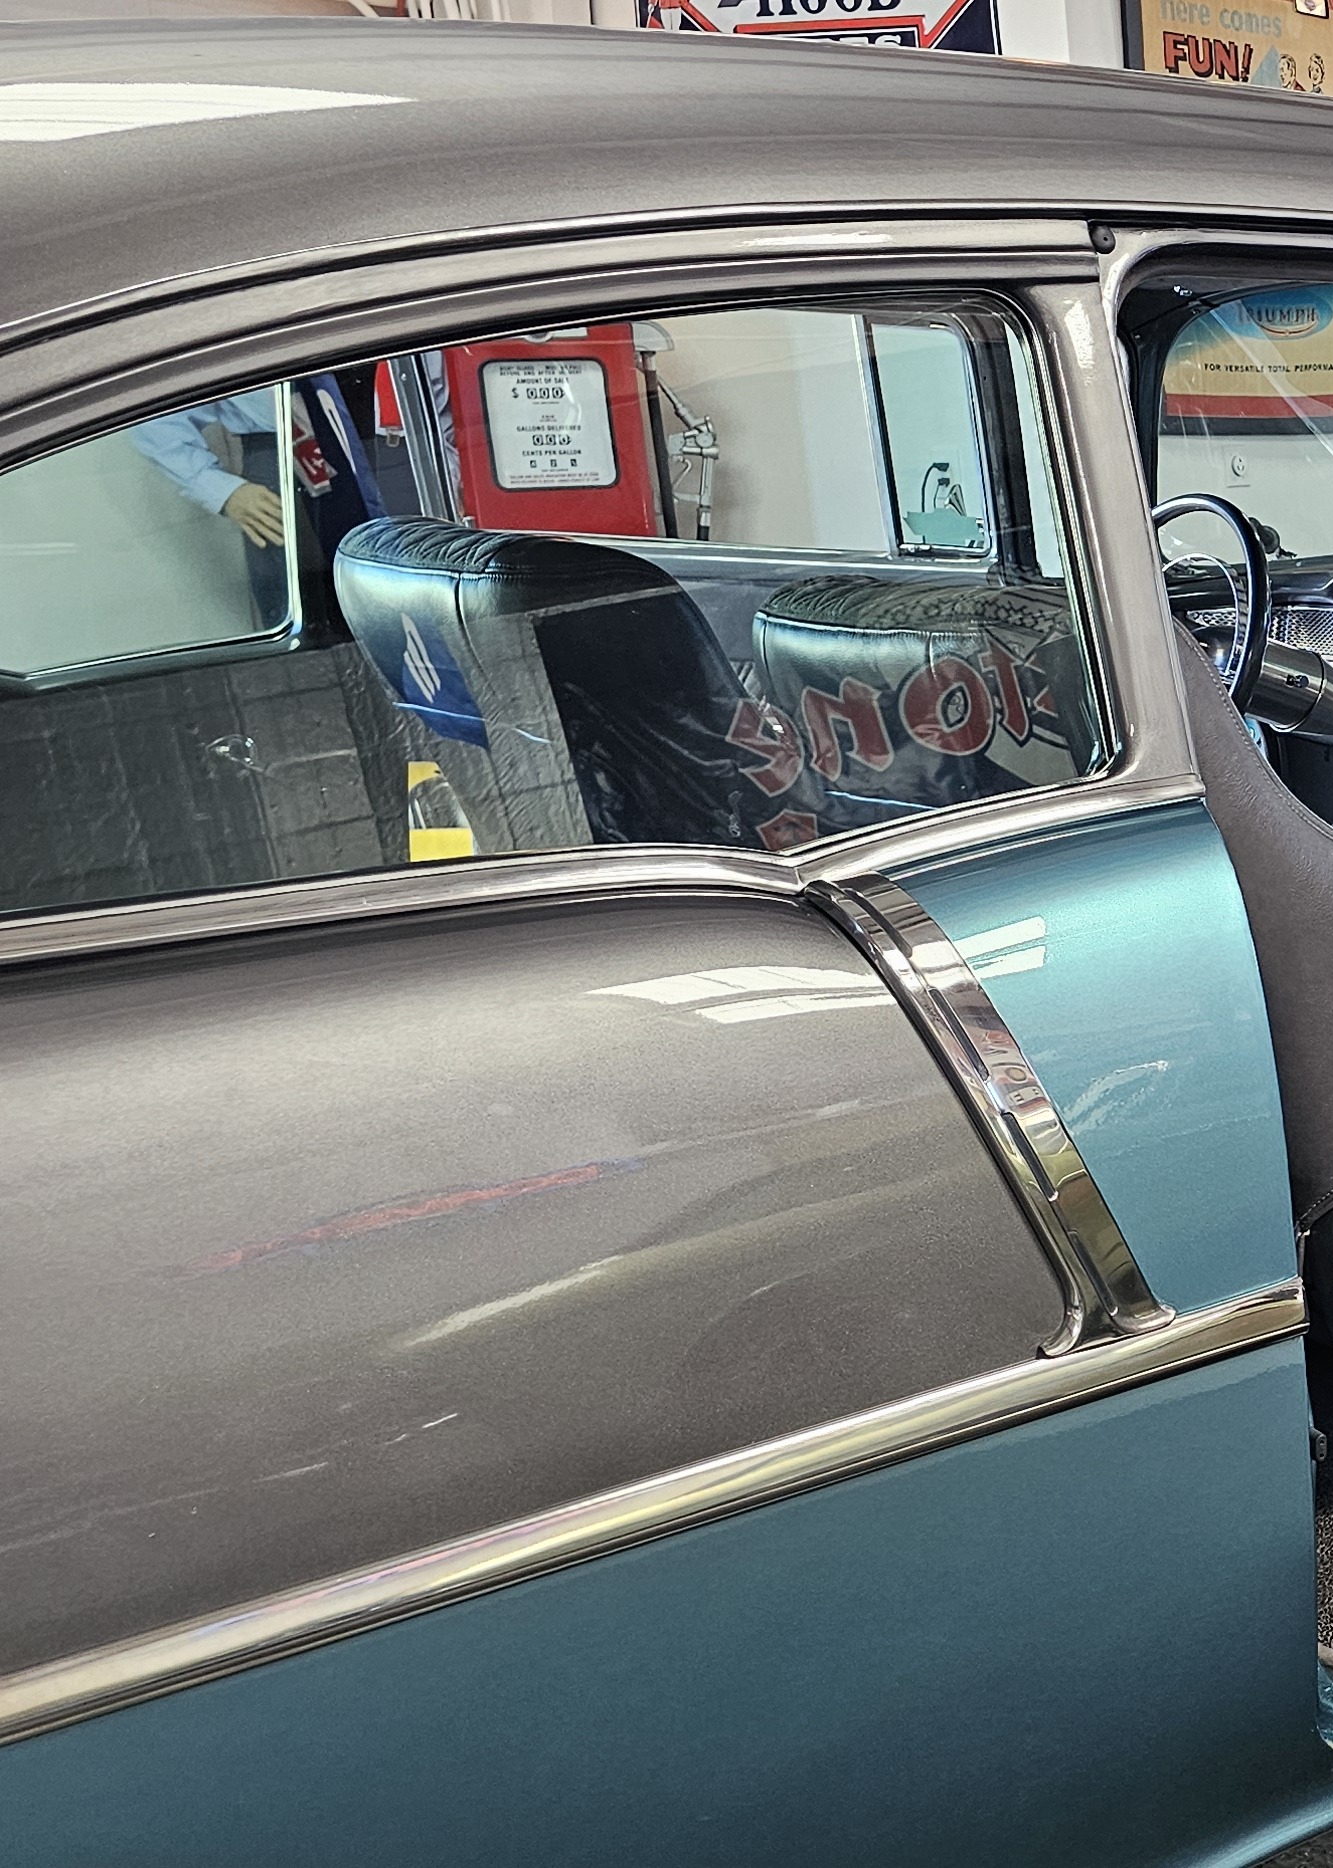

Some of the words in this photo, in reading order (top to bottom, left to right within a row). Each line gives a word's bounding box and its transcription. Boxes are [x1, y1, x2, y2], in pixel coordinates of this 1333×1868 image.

[1218, 8, 1282, 37] comes
[1162, 30, 1254, 82] FUN!
[1204, 363, 1221, 372] FOR
[1268, 365, 1291, 373] TOTAL
